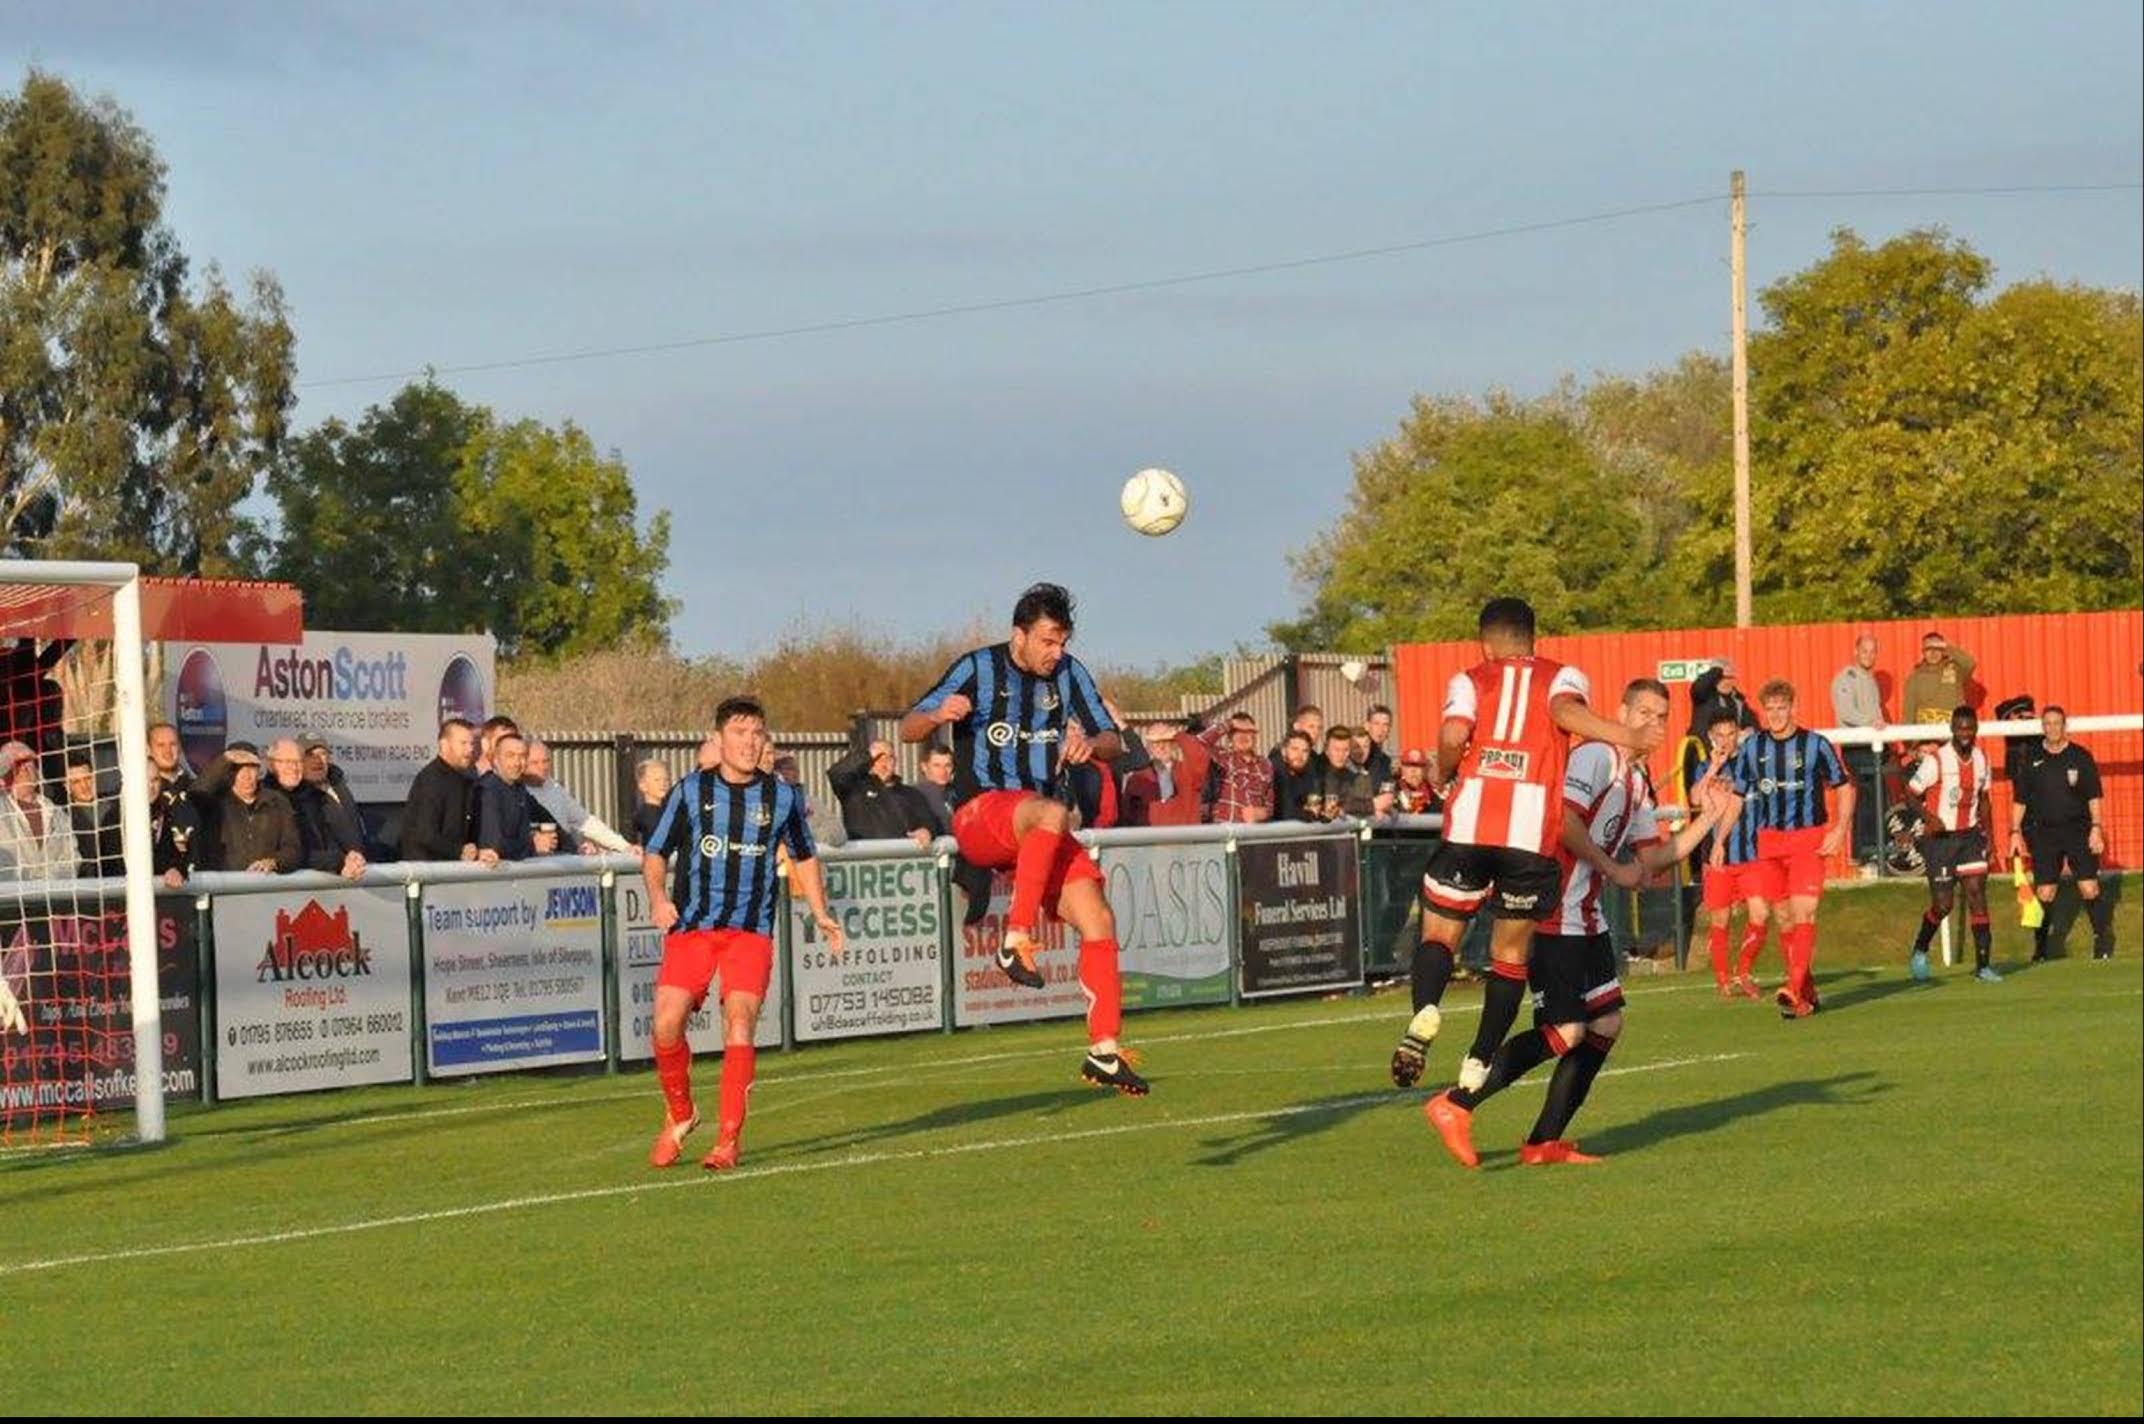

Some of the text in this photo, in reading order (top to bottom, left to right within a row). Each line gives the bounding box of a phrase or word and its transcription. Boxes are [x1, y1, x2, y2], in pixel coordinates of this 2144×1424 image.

[254, 645, 407, 700] AstonScott
[254, 705, 411, 730] chartered insurance brokers
[827, 862, 935, 900] DIRECT
[1277, 852, 1319, 888] Havill
[426, 886, 597, 932] Team support by JEWSON
[1109, 859, 1226, 953] OASIS
[1254, 895, 1347, 926] Funeral Services Ltd
[257, 930, 371, 983] Alcock
[802, 944, 938, 970] SCAFFOLDING
[842, 970, 893, 987] CONTACT
[285, 986, 326, 1011] Roofing
[810, 991, 867, 1014] 07753
